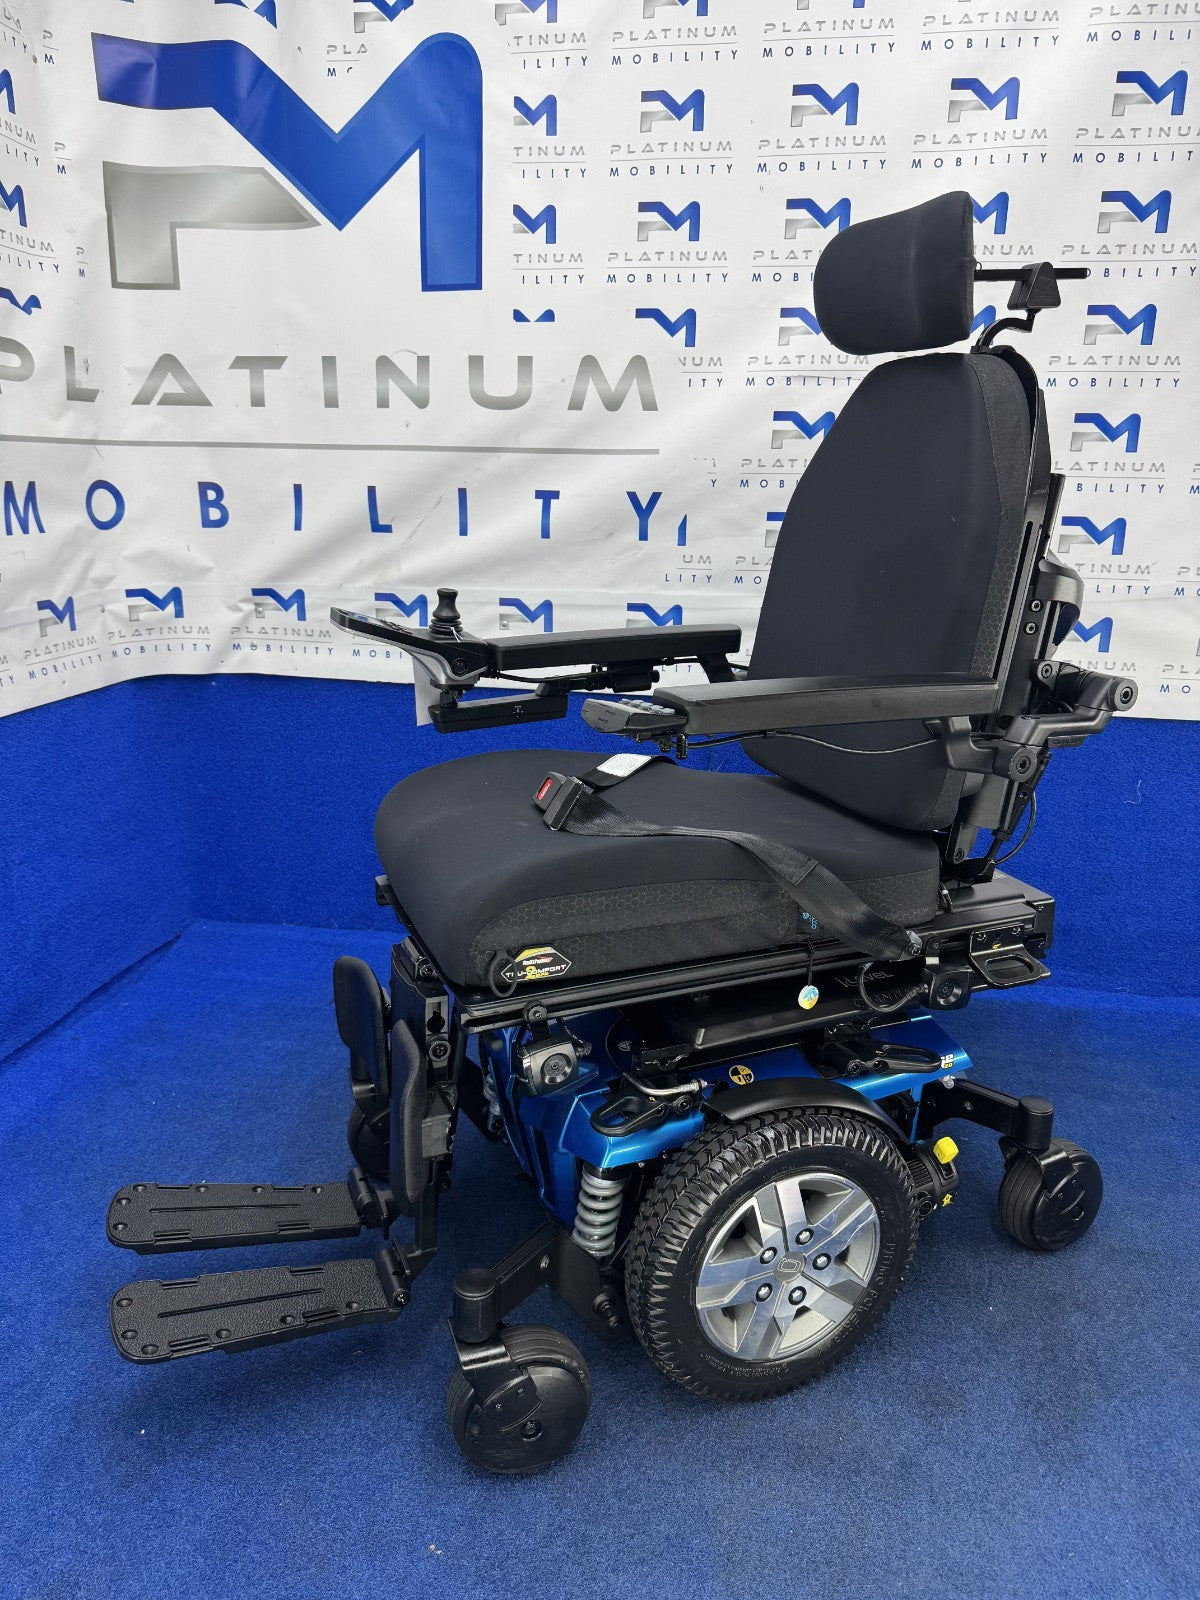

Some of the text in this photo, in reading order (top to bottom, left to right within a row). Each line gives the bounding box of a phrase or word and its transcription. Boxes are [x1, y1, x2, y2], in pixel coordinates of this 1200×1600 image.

[763, 17, 895, 35] PLATINUM
[922, 10, 1060, 27] PLATINUM
[612, 25, 738, 42] PLATINUM
[762, 42, 896, 58] MOBILITY
[920, 34, 1060, 51] MOBILITY
[611, 49, 738, 66] MOBILITY
[758, 134, 887, 151] PLATINUM
[912, 127, 1048, 146] PLATINUM
[609, 140, 733, 156] PLATINUM
[757, 159, 887, 173] MOBILITY
[911, 152, 1048, 169] MOBILITY
[608, 163, 733, 178] MOBILITY
[607, 250, 729, 263] PLATINUM
[1061, 242, 1198, 255] PLATINUM
[606, 272, 729, 284] MOBILITY
[747, 354, 869, 366] PLATINUM
[1048, 355, 1182, 366] PLATINUM
[0, 336, 659, 412] PLATINUM
[1046, 377, 1181, 388] MOBILITY
[3, 478, 663, 542] MOBILITY
[107, 625, 210, 641] PLATINUM
[230, 626, 332, 638] PLATINUM
[24, 636, 98, 660] PLATINUM
[112, 642, 212, 658] MOBILITY
[232, 642, 334, 656] MOBILITY
[28, 653, 103, 680] MOBILITY
